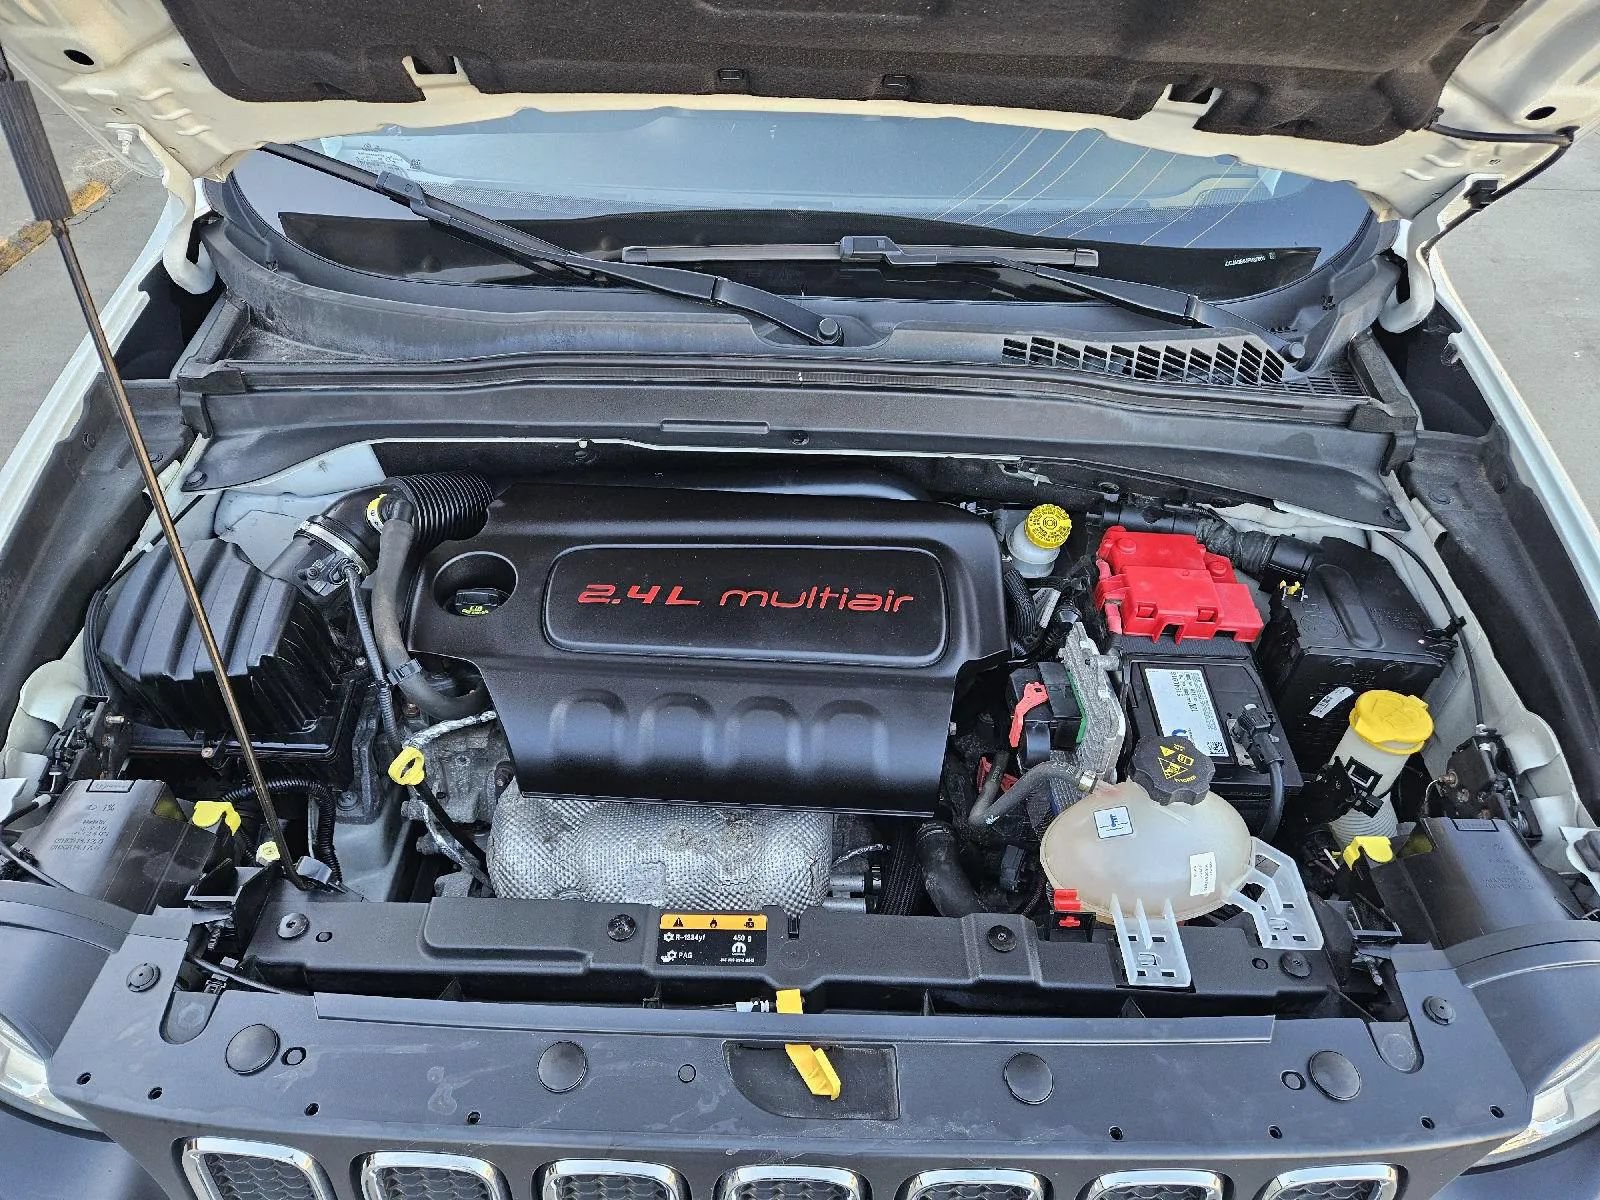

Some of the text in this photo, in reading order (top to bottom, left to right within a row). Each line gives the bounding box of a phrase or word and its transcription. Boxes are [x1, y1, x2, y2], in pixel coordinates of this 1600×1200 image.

[719, 586, 914, 612] multiair
[675, 933, 706, 942] R-1234yf
[733, 934, 746, 942] 450
[678, 951, 693, 959] PAG
